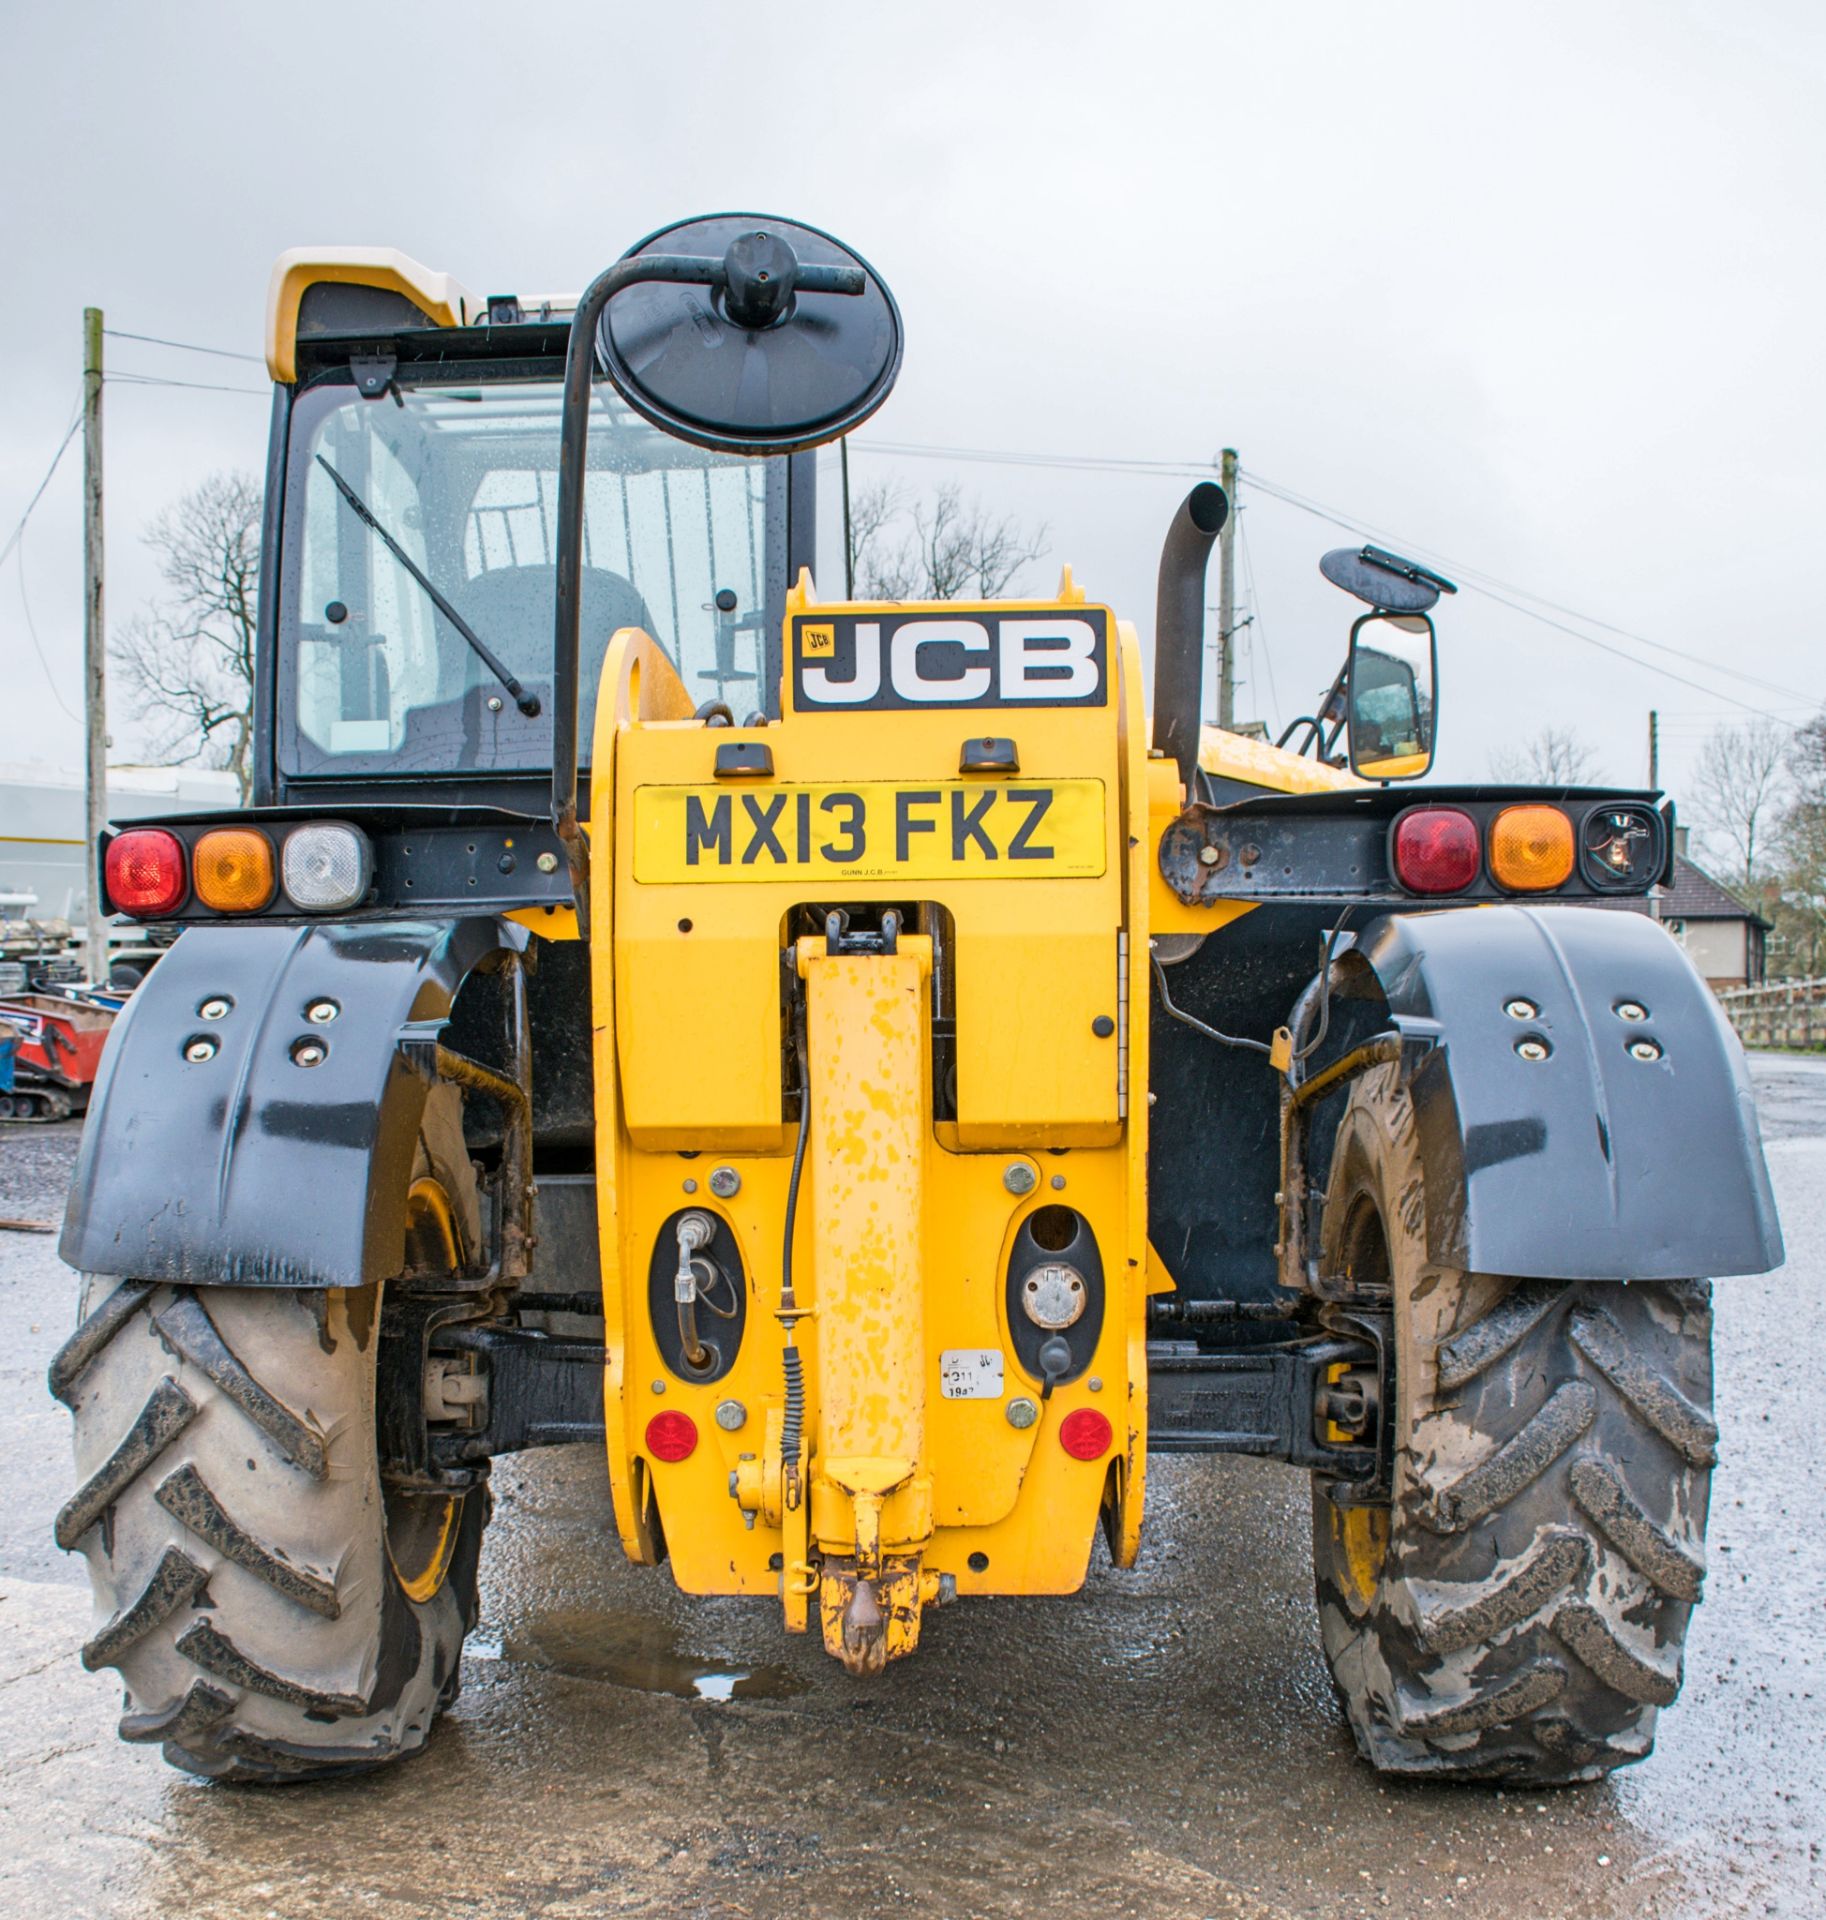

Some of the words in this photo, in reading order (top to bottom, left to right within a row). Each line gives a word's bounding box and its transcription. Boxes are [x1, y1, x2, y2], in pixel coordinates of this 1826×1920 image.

[801, 618, 1099, 704] JCB
[810, 632, 829, 649] JCB
[686, 792, 866, 865] MX13
[895, 788, 1055, 862] FKZ
